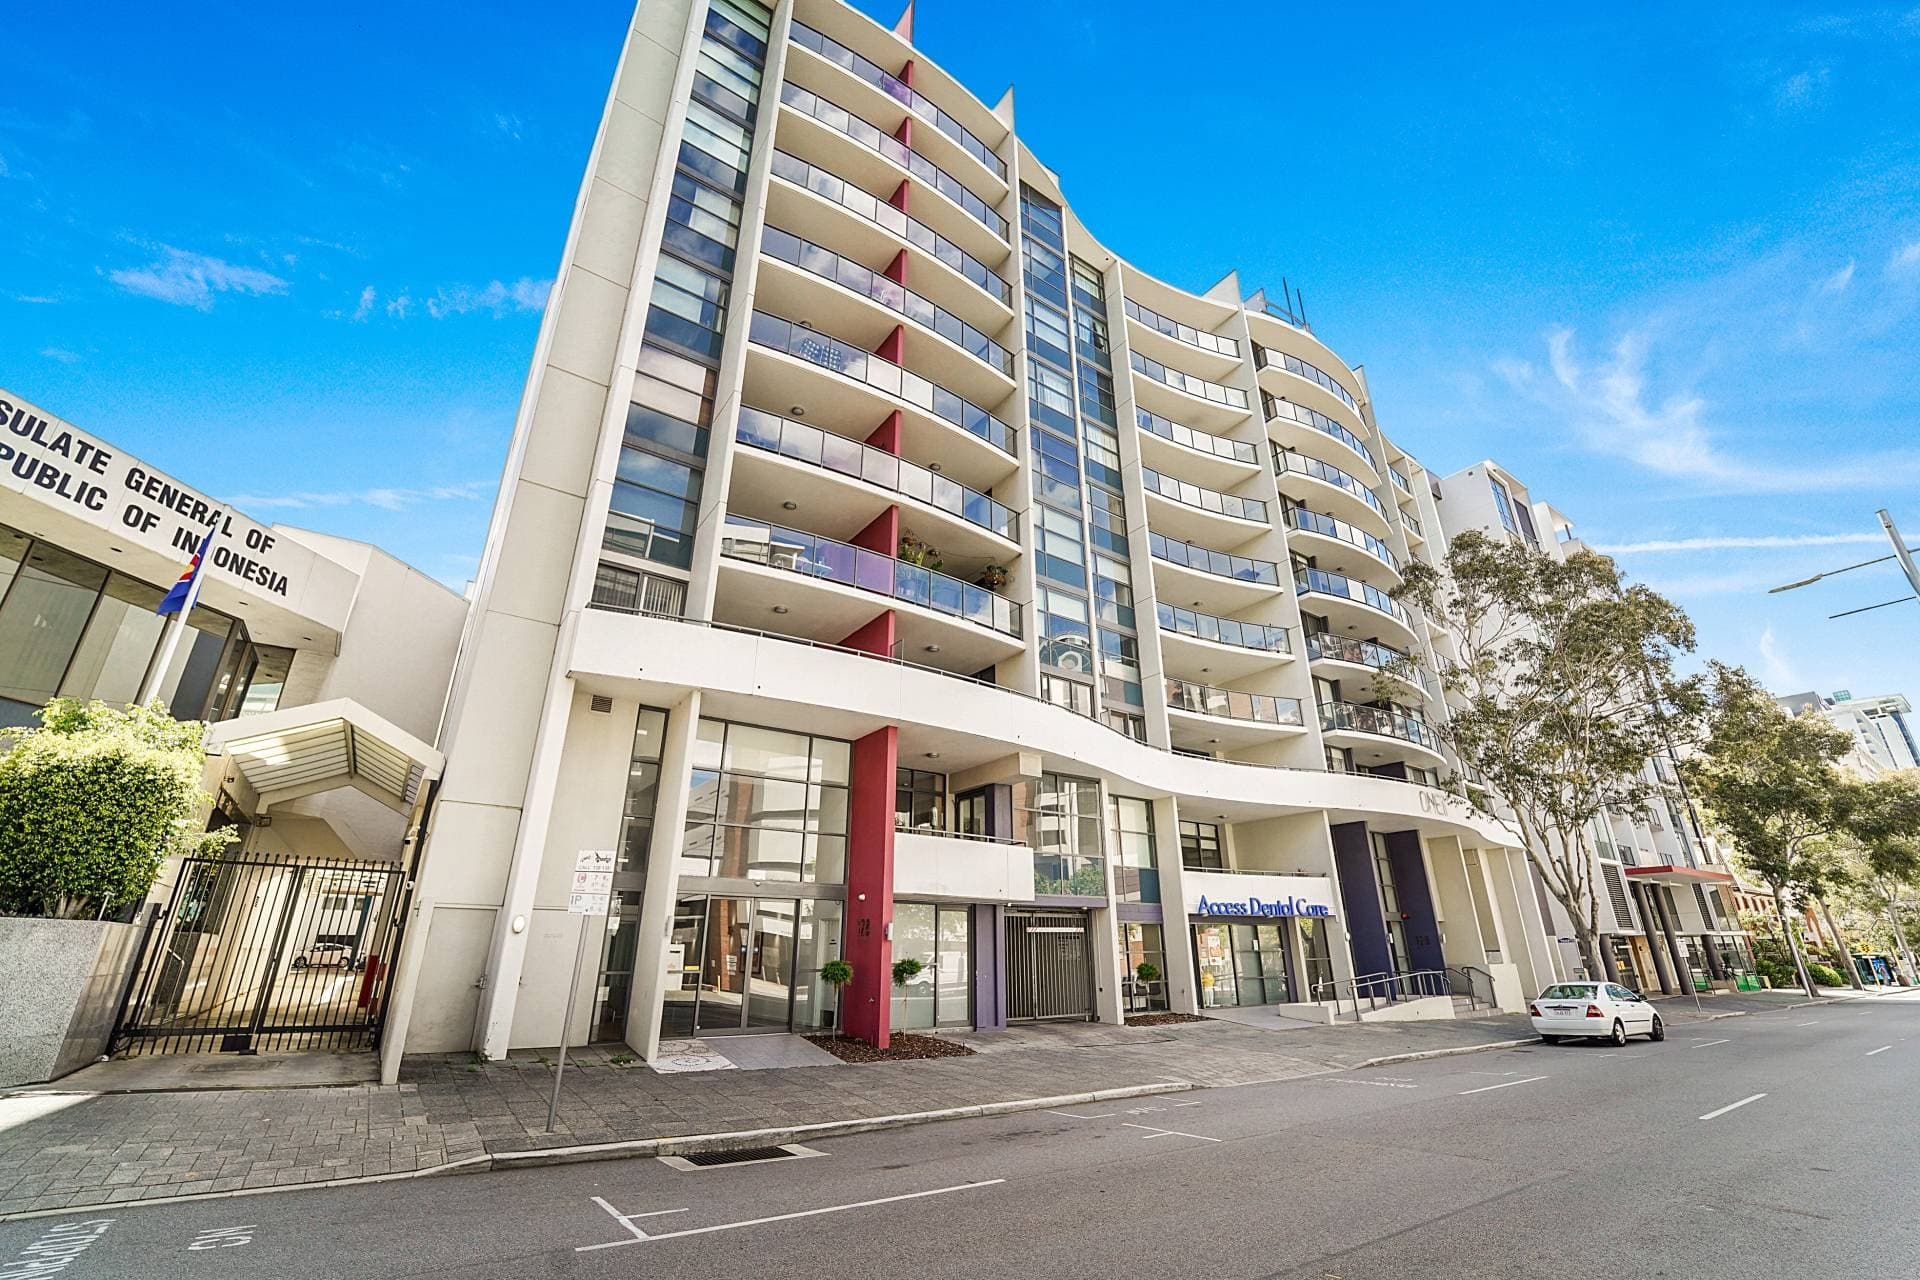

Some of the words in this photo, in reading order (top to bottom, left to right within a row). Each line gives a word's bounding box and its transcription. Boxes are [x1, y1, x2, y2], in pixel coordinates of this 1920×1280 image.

[122, 503, 161, 534] OF
[171, 526, 288, 597] INONESIA
[124, 467, 233, 538] GENERAL
[245, 528, 275, 554] OF
[1198, 895, 1247, 915] Access
[1250, 896, 1293, 917] Dental
[1296, 899, 1329, 917] Care
